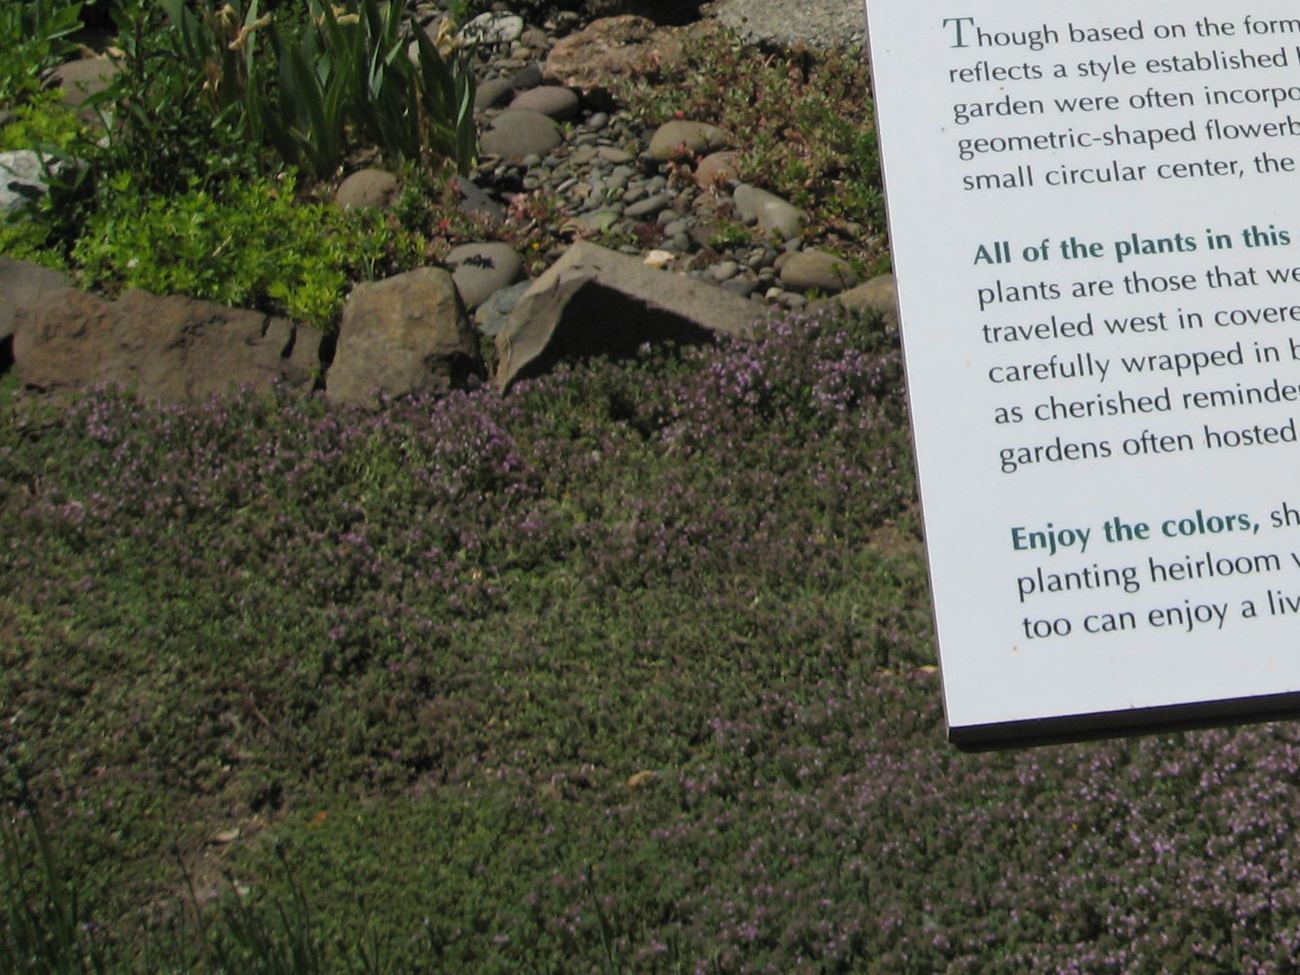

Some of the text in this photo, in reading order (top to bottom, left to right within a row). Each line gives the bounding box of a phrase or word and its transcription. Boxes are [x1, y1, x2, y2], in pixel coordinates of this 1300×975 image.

[942, 16, 1059, 52] Though
[1067, 19, 1145, 43] based
[1153, 24, 1186, 39] on
[1194, 16, 1235, 38] the
[949, 60, 1043, 83] reflects
[1053, 63, 1068, 79] a
[1077, 54, 1137, 83] style
[1145, 46, 1289, 74] established
[953, 94, 1044, 126] garden
[1053, 96, 1120, 113] were
[1128, 87, 1195, 109] often
[957, 119, 1197, 162] geometric-shaped
[962, 164, 1034, 191] small
[1045, 160, 1147, 186] circular
[1156, 159, 1244, 180] center,
[1253, 151, 1296, 174] the
[973, 240, 1012, 266] All
[1022, 238, 1050, 263] of
[1059, 236, 1105, 260] the
[1114, 232, 1198, 264] plants
[1205, 228, 1233, 250] in
[1241, 224, 1291, 248] this
[977, 279, 1061, 312] plants
[1072, 280, 1114, 298] are
[1123, 270, 1197, 295] those
[1205, 265, 1259, 289] that
[981, 312, 1094, 344] traveled
[1103, 312, 1169, 335] west
[1177, 307, 1204, 330] in
[988, 352, 1110, 384] carefully
[1120, 340, 1244, 378] wrapped
[1253, 341, 1280, 364] in
[994, 406, 1024, 425] as
[1034, 386, 1172, 422] cherished
[999, 436, 1112, 474] gardens
[1122, 428, 1194, 456] often
[1203, 417, 1298, 449] hosted
[1010, 522, 1091, 557] Enjoy
[1102, 516, 1150, 543] the
[1161, 509, 1260, 538] colors,
[1017, 563, 1141, 604] planting
[1148, 551, 1281, 583] heirloom
[1021, 617, 1072, 640] too
[1083, 611, 1137, 634] can
[1148, 599, 1228, 633] enjoy
[1241, 600, 1258, 619] a
